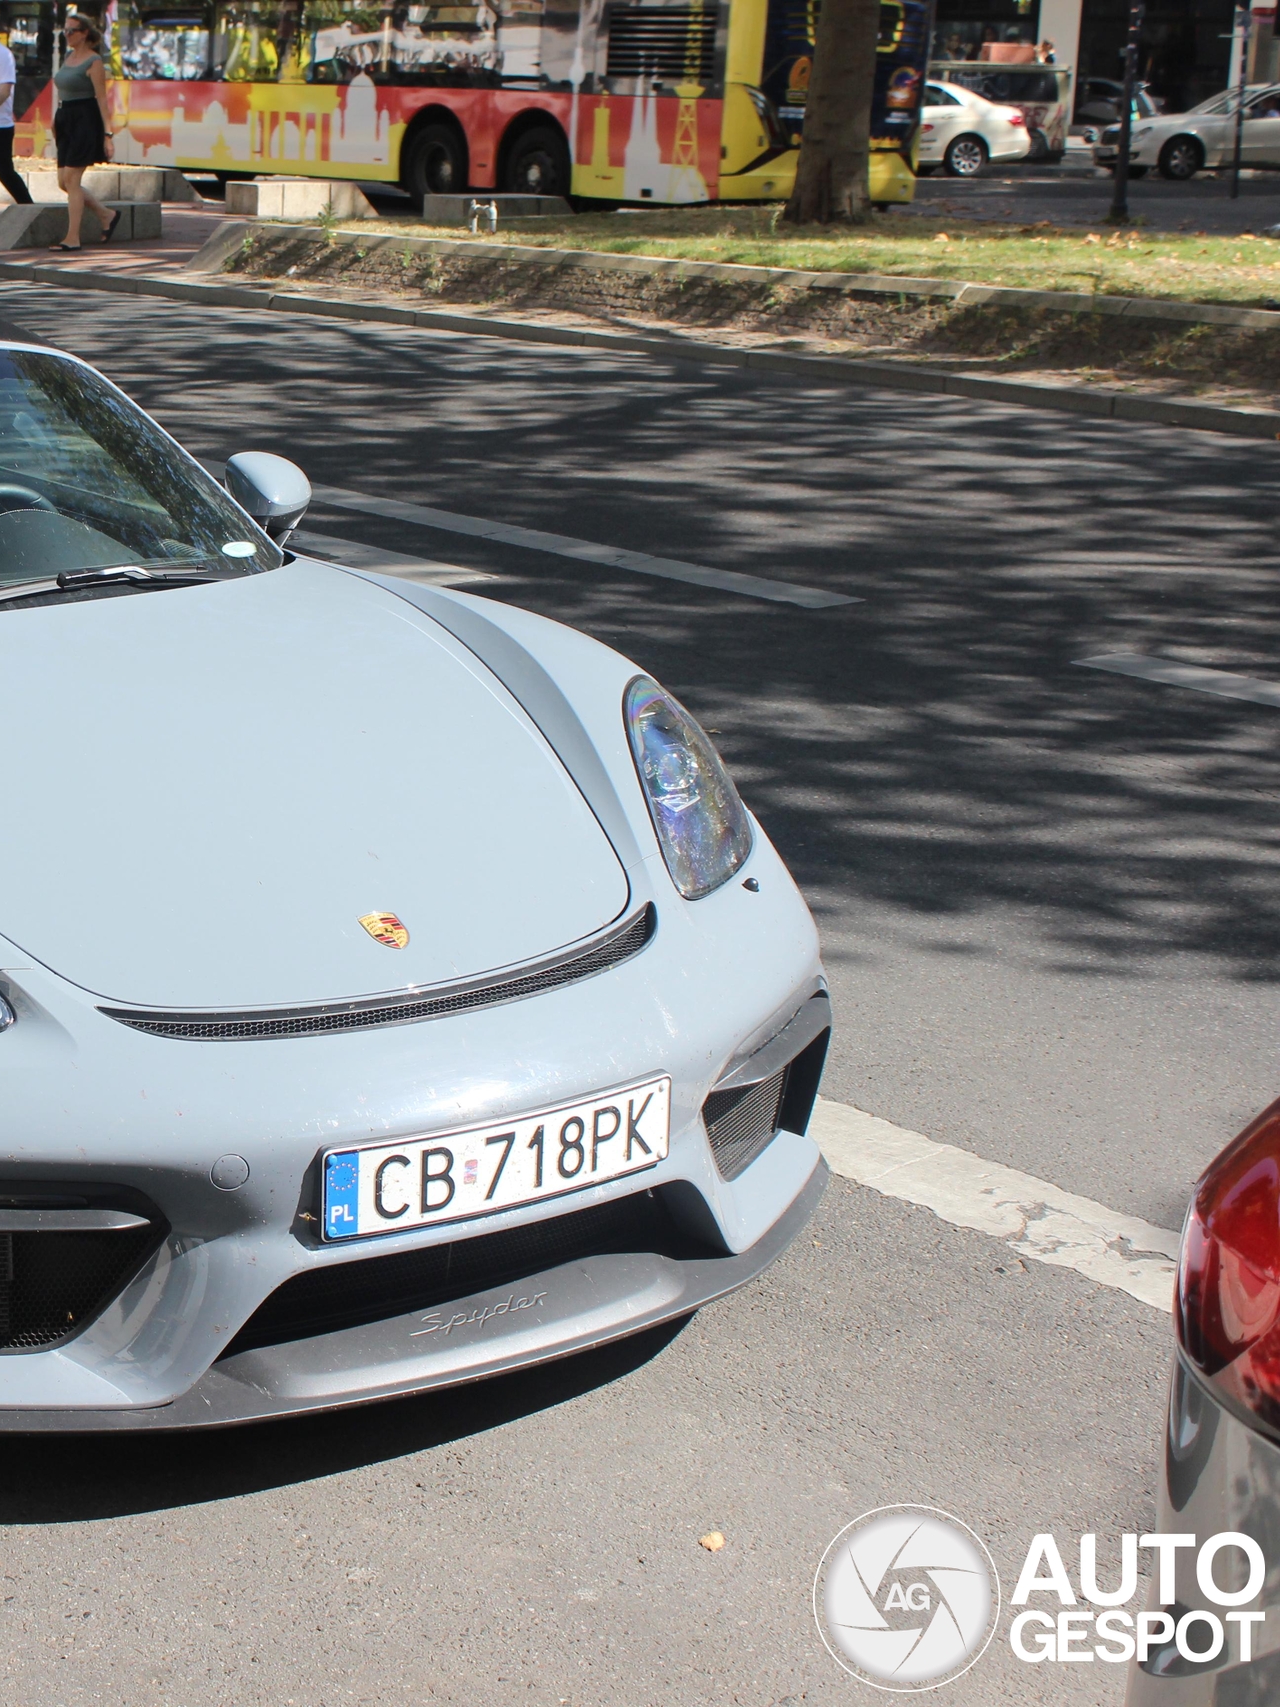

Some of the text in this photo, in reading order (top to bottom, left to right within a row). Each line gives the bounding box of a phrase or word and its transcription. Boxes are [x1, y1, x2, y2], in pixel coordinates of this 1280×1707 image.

[374, 1092, 655, 1219] CB 718PK
[330, 1204, 355, 1223] PL
[409, 1290, 548, 1338] Spyder
